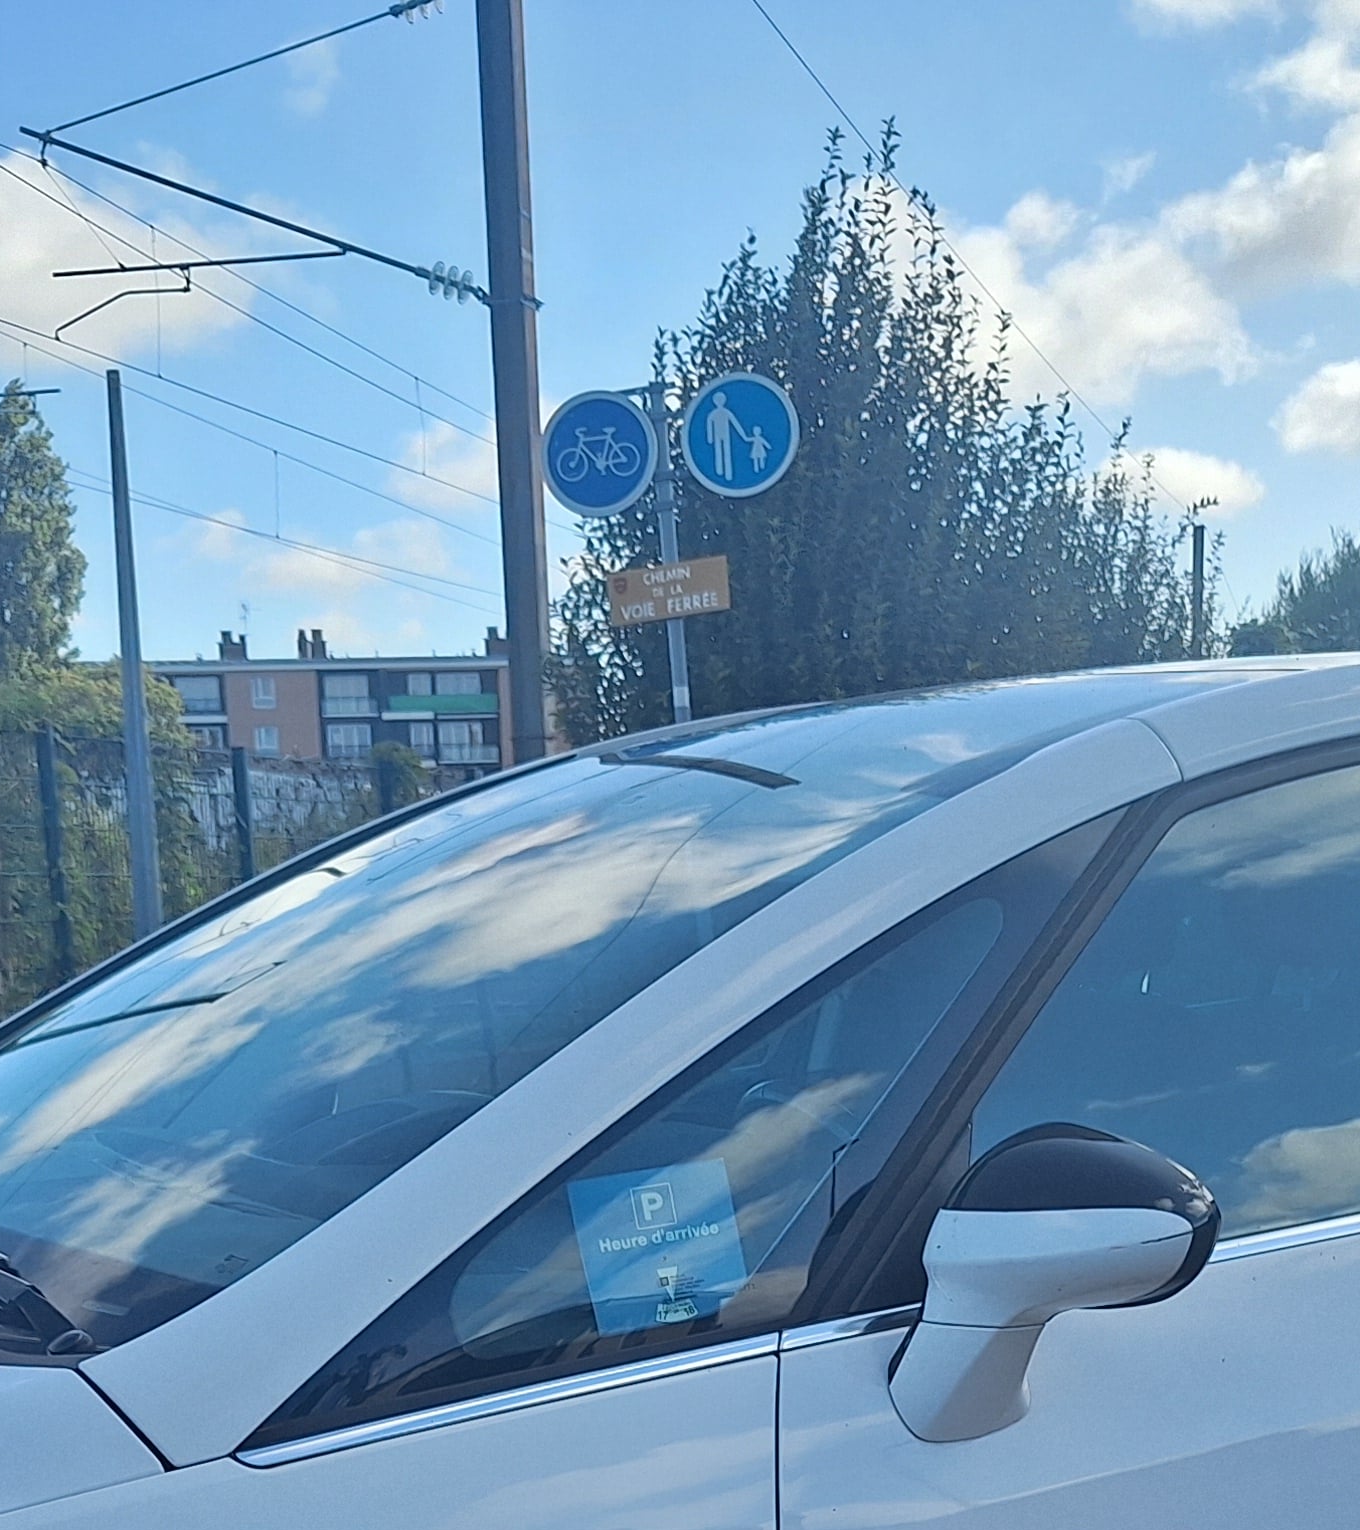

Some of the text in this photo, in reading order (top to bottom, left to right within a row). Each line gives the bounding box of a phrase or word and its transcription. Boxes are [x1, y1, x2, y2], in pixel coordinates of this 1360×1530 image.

[643, 567, 691, 586] CHEMIN
[652, 584, 684, 598] DE LA
[620, 592, 719, 620] VOIE FERRÉE
[640, 1191, 664, 1221] P
[598, 1220, 720, 1254] Heure d'arrivée
